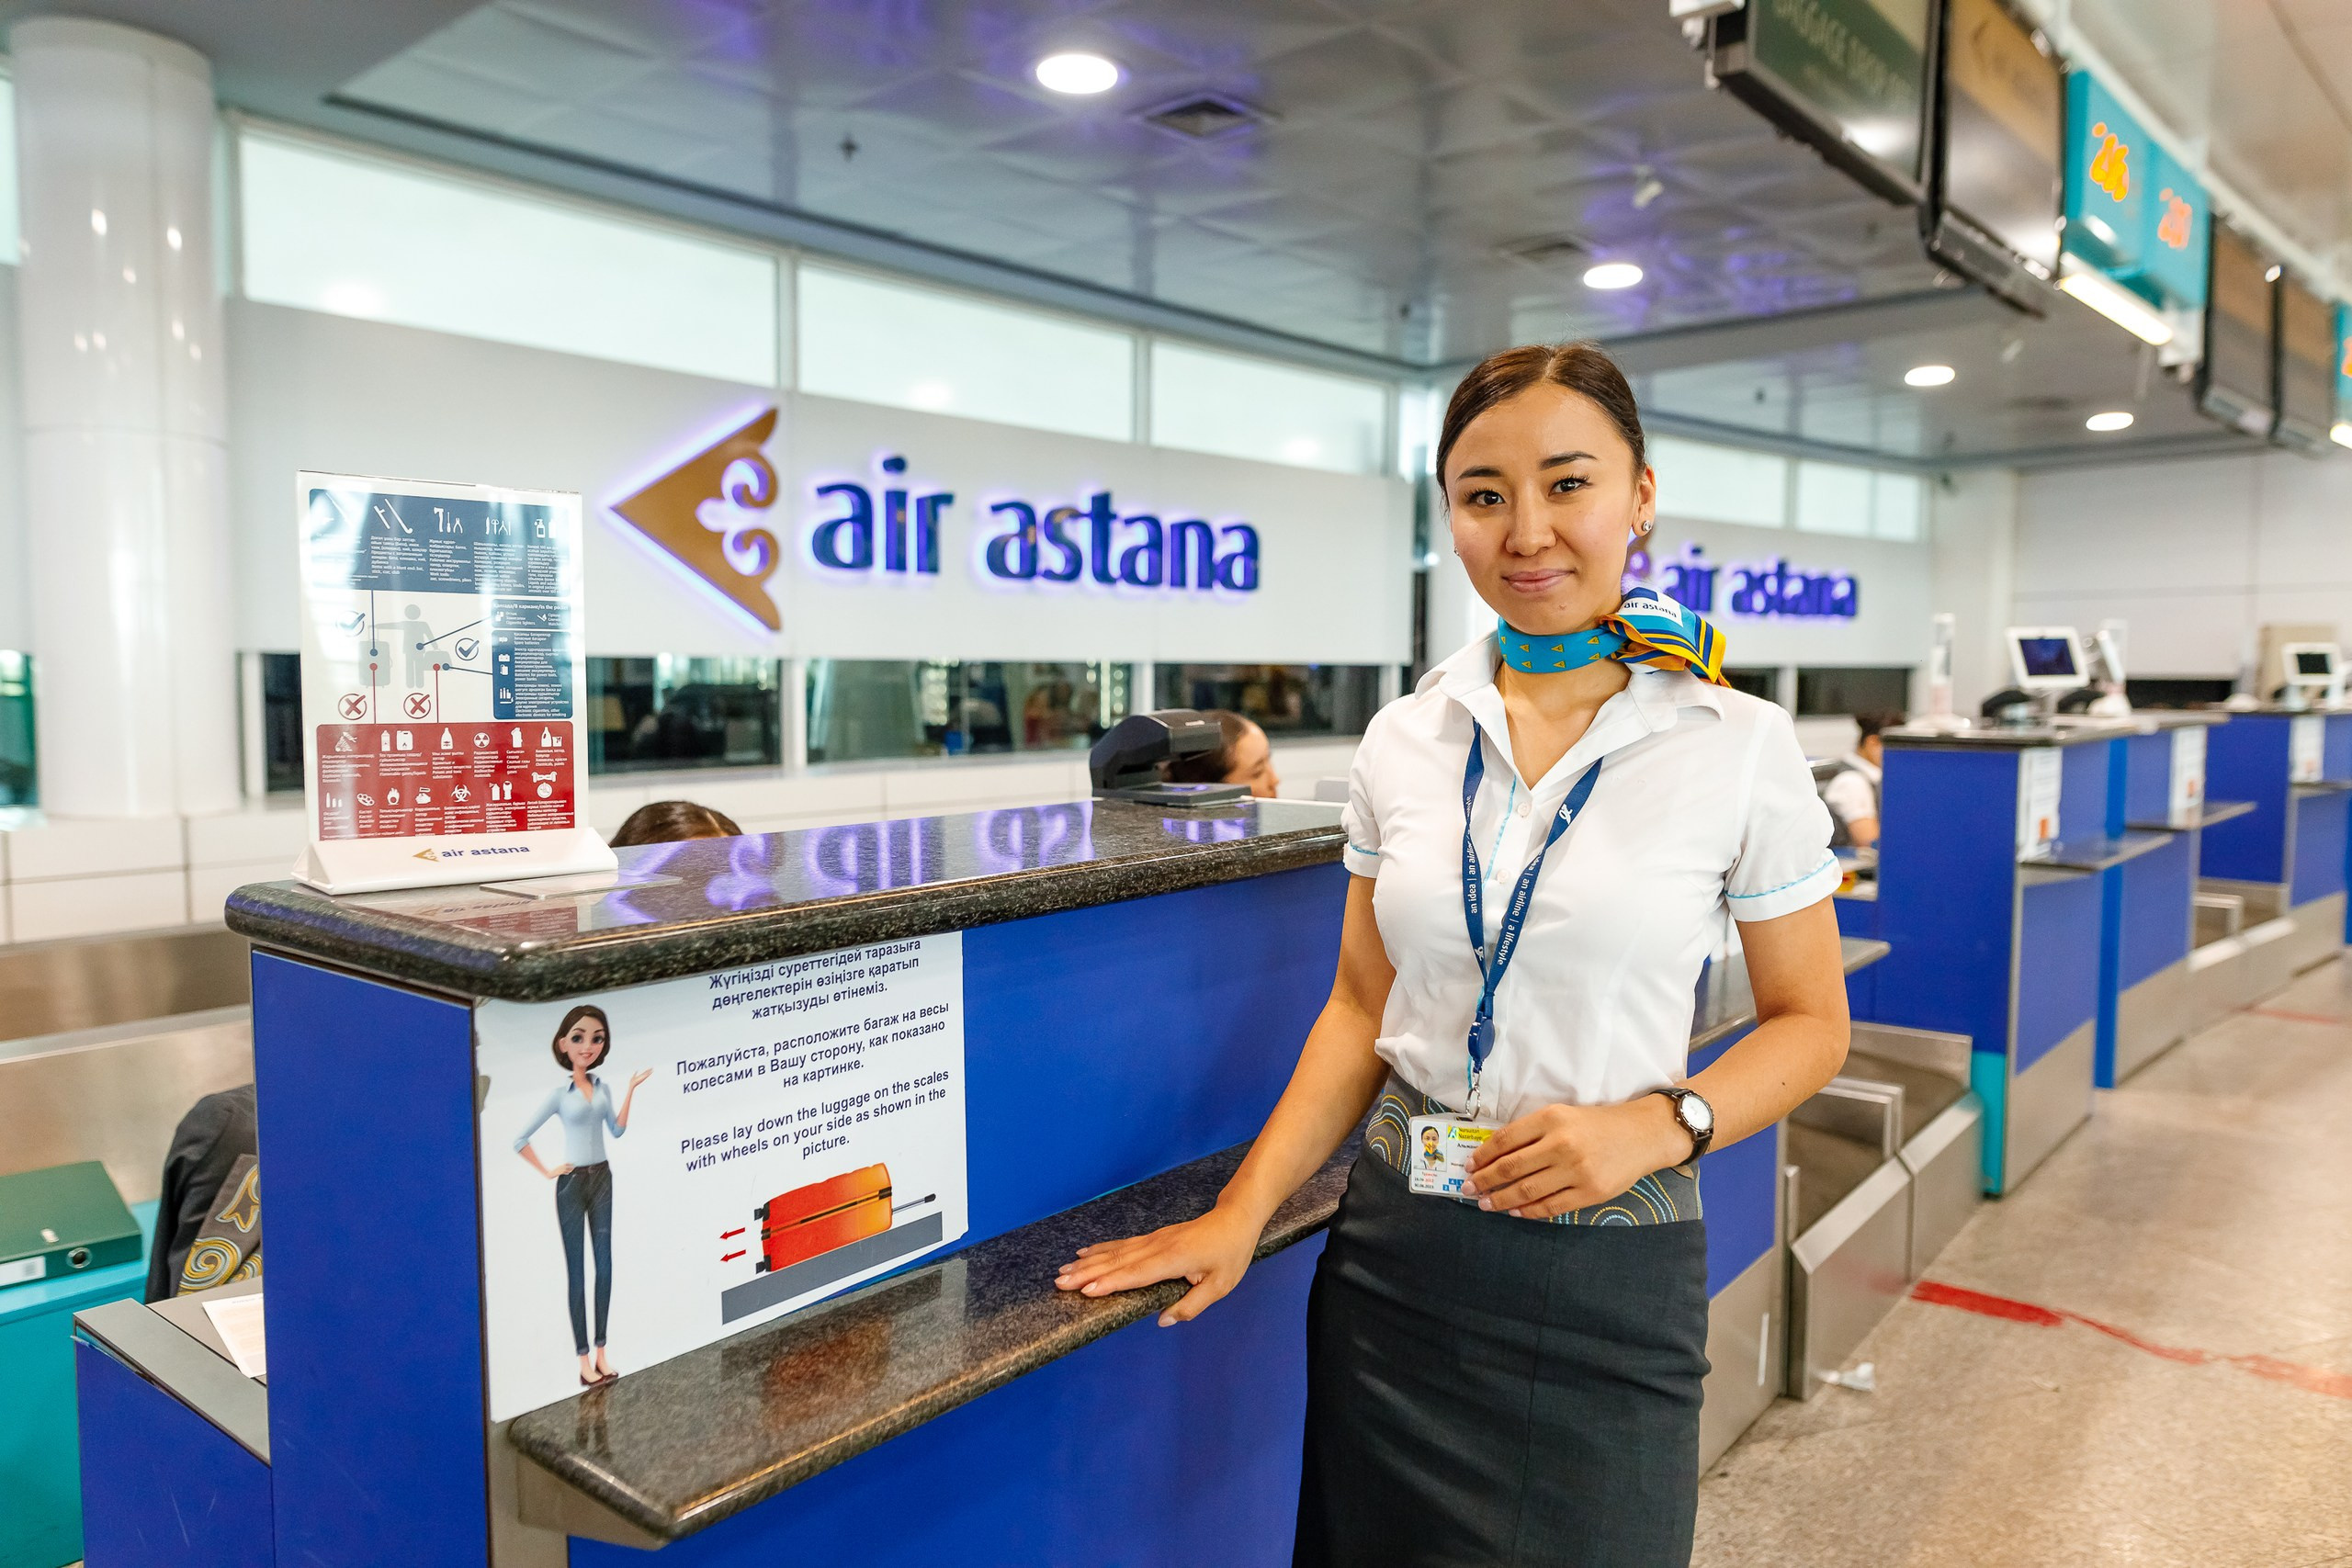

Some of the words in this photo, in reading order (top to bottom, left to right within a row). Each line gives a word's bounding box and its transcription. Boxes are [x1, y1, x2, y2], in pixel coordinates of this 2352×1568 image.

[812, 456, 955, 575] air
[986, 491, 1261, 592] astana
[1732, 559, 1859, 616] astana
[1623, 600, 1639, 609] air
[1642, 603, 1678, 618] astana
[442, 849, 465, 858] air
[470, 846, 530, 856] astana
[1469, 865, 1476, 875] an
[1521, 878, 1530, 889] an
[1467, 884, 1477, 902] idea
[1471, 903, 1477, 914] an
[1511, 890, 1527, 917] airline
[1497, 931, 1515, 965] lifestyle
[709, 964, 775, 990] Жүгіңізді
[779, 947, 862, 978] суреттегідей
[865, 941, 921, 963] таразыға
[712, 979, 813, 1010] дөңгелектерін
[817, 968, 865, 989] өзіңізге
[869, 957, 919, 979] қаратып
[752, 994, 830, 1020] жатқызуды
[833, 983, 888, 1002] өтінеміз.
[677, 1044, 770, 1076] Пожалуйста,
[774, 1022, 861, 1057] расположите
[864, 1015, 899, 1031] багаж
[902, 1011, 917, 1022] на
[920, 1002, 949, 1019] весы
[684, 1068, 752, 1094] колесами
[758, 1065, 766, 1075] в
[771, 1053, 807, 1072] Вашу
[810, 1040, 865, 1063] сторону,
[869, 1032, 888, 1048] как
[891, 1020, 945, 1042] показано
[783, 1075, 798, 1089] на
[803, 1058, 864, 1082] картинке.
[681, 1129, 729, 1155] Please
[733, 1123, 752, 1144] lay
[757, 1112, 794, 1134] down
[797, 1106, 818, 1123] the
[821, 1091, 871, 1116] luggage
[874, 1088, 888, 1100] on
[892, 1082, 910, 1095] the
[913, 1069, 949, 1089] scales
[687, 1153, 716, 1172] with
[721, 1137, 769, 1161] wheels
[773, 1134, 790, 1148] on
[794, 1123, 823, 1147] your
[827, 1113, 853, 1133] side
[856, 1111, 870, 1123] as
[874, 1097, 912, 1118] shown
[915, 1093, 925, 1106] in
[929, 1087, 946, 1102] the
[802, 1134, 850, 1160] picture.
